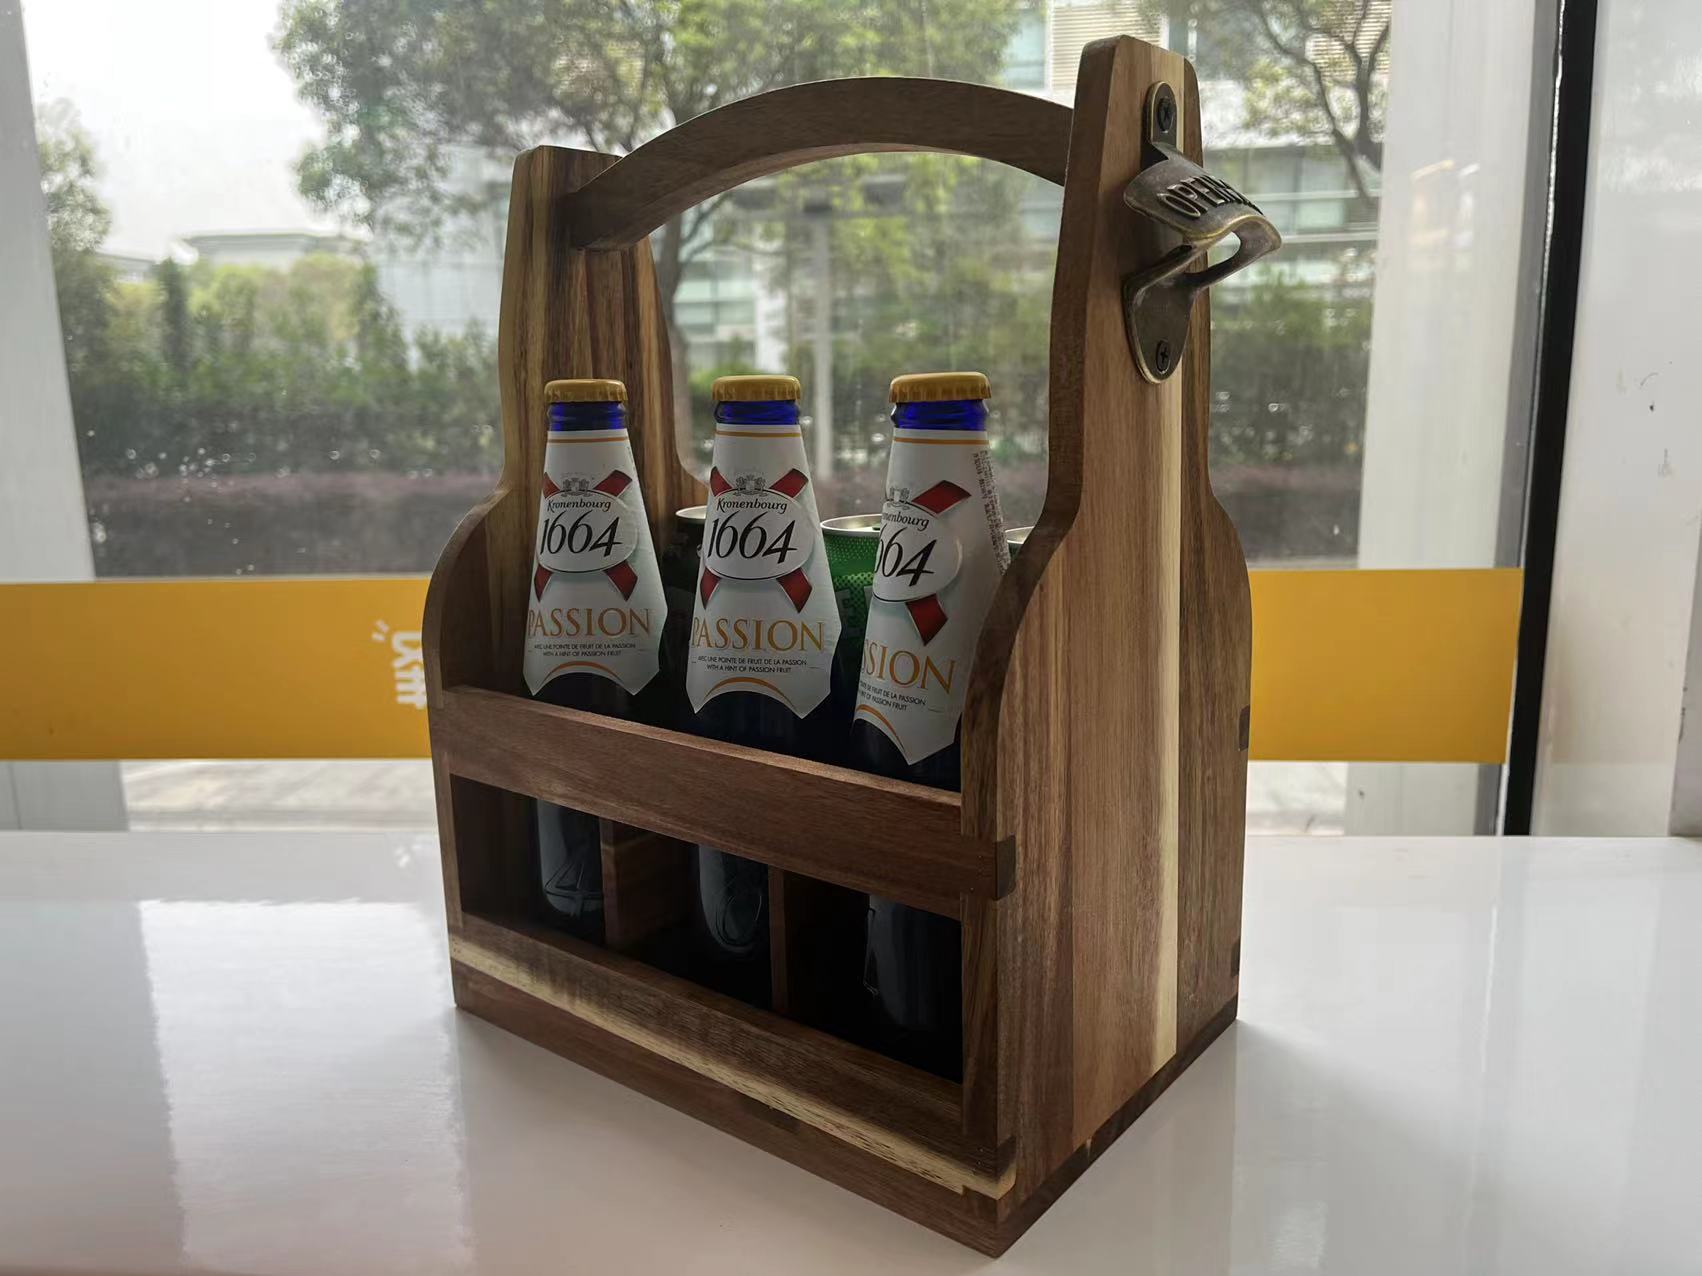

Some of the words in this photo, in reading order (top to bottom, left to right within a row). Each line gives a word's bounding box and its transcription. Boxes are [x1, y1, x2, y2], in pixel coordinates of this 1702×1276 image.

[547, 498, 612, 513] Kronenbourg
[716, 497, 788, 515] Kronenbourg
[540, 510, 623, 558] 1664
[707, 509, 798, 565] 1664
[874, 523, 938, 587] 664
[528, 607, 651, 638] PASSION
[690, 616, 826, 652] PASSION
[718, 656, 737, 664] POINTE
[861, 638, 957, 695] SSION
[872, 695, 892, 706] PASSION
[892, 701, 907, 711] FRUIT
[898, 694, 926, 706] PASSION
